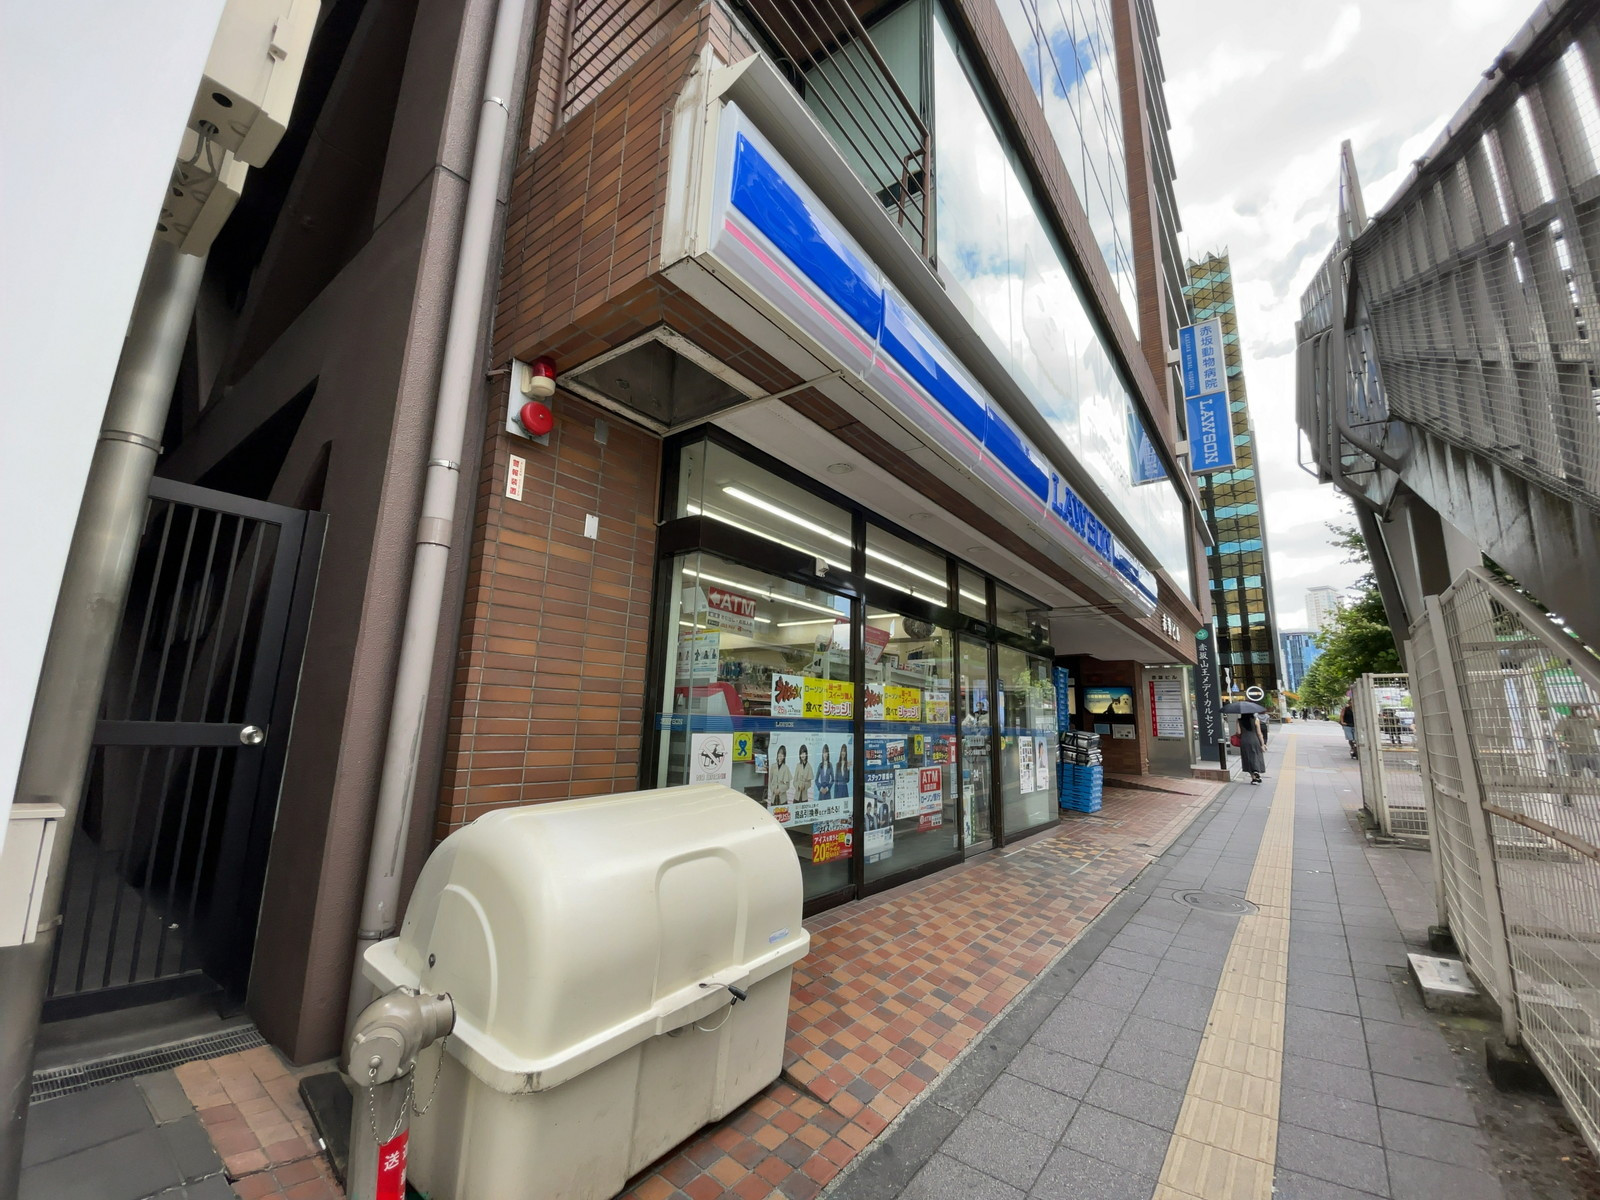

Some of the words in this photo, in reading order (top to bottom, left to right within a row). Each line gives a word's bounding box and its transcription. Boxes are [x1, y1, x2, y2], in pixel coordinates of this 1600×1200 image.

[1199, 325, 1218, 390] 赤坂動物病院
[1199, 398, 1219, 465] LAWSON
[1051, 472, 1112, 562] LAWSON
[720, 593, 756, 616] ATM
[804, 685, 823, 693] ローソン
[1198, 643, 1215, 745] 赤坂山王メディカルセンター
[922, 770, 938, 784] ATM
